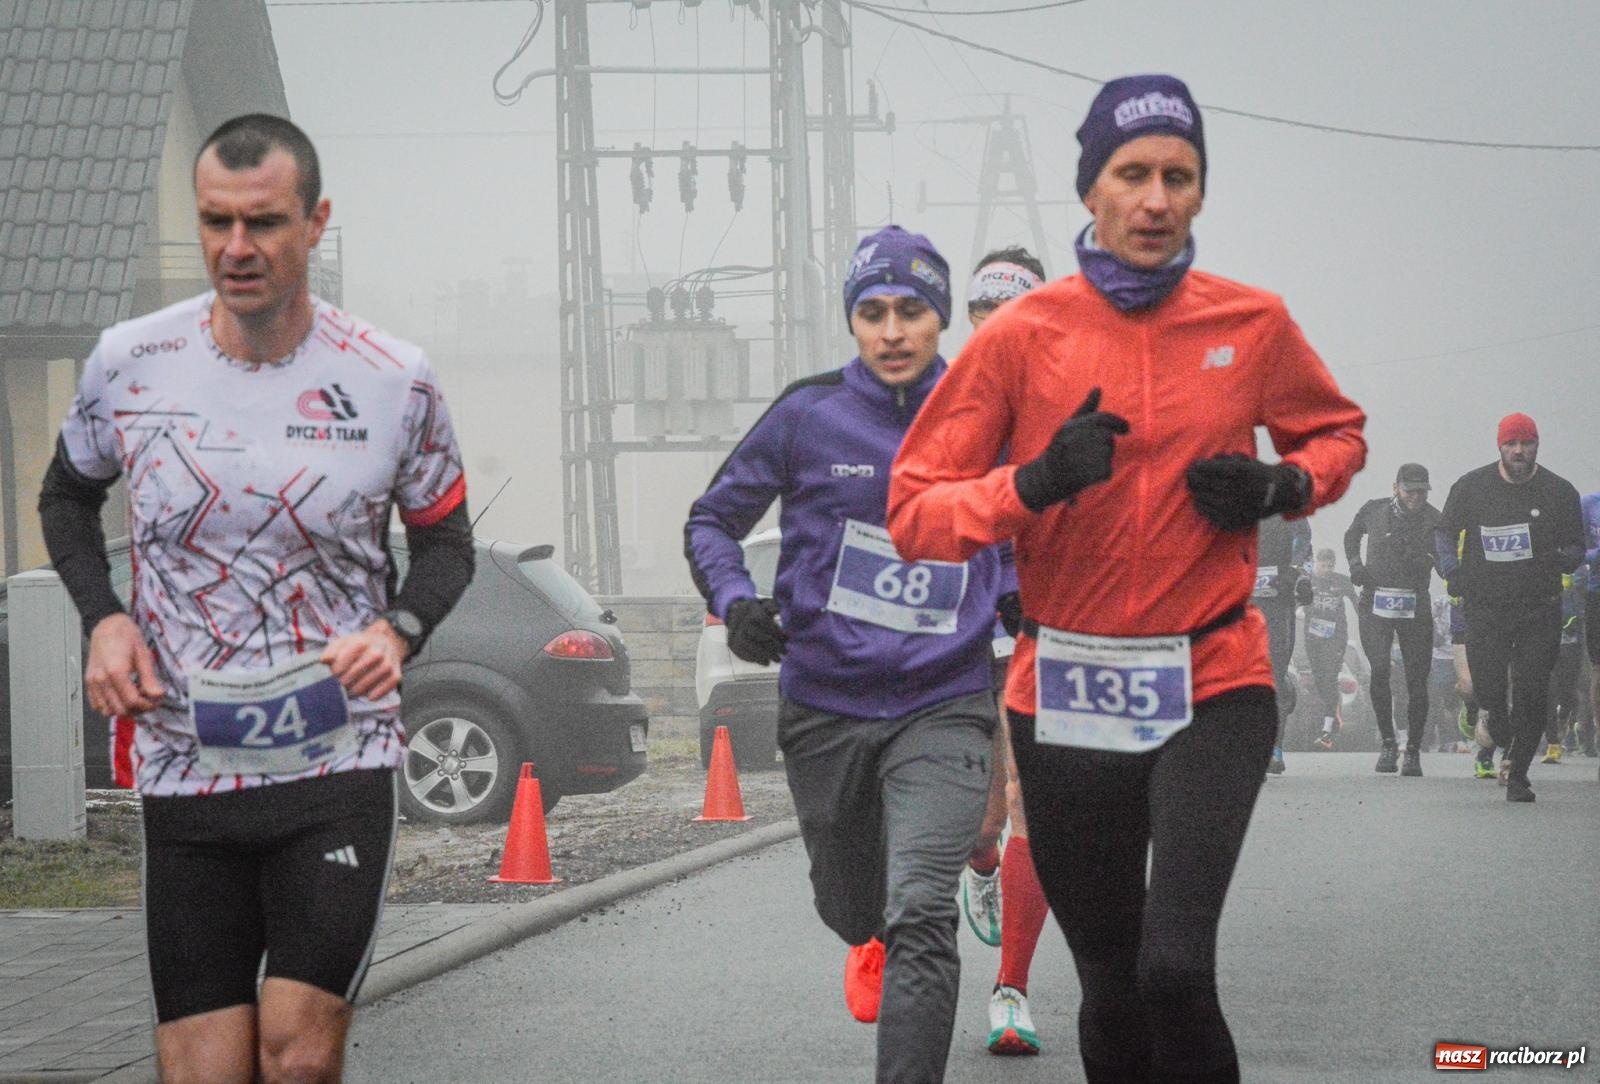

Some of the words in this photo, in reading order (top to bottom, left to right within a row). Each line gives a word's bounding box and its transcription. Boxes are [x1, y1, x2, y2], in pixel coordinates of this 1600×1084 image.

[131, 337, 187, 358] deep
[336, 428, 368, 441] TEAM
[1489, 535, 1522, 551] 172
[874, 563, 932, 605] 68
[1386, 597, 1404, 610] 34
[1065, 666, 1160, 718] 135
[236, 695, 307, 746] 24
